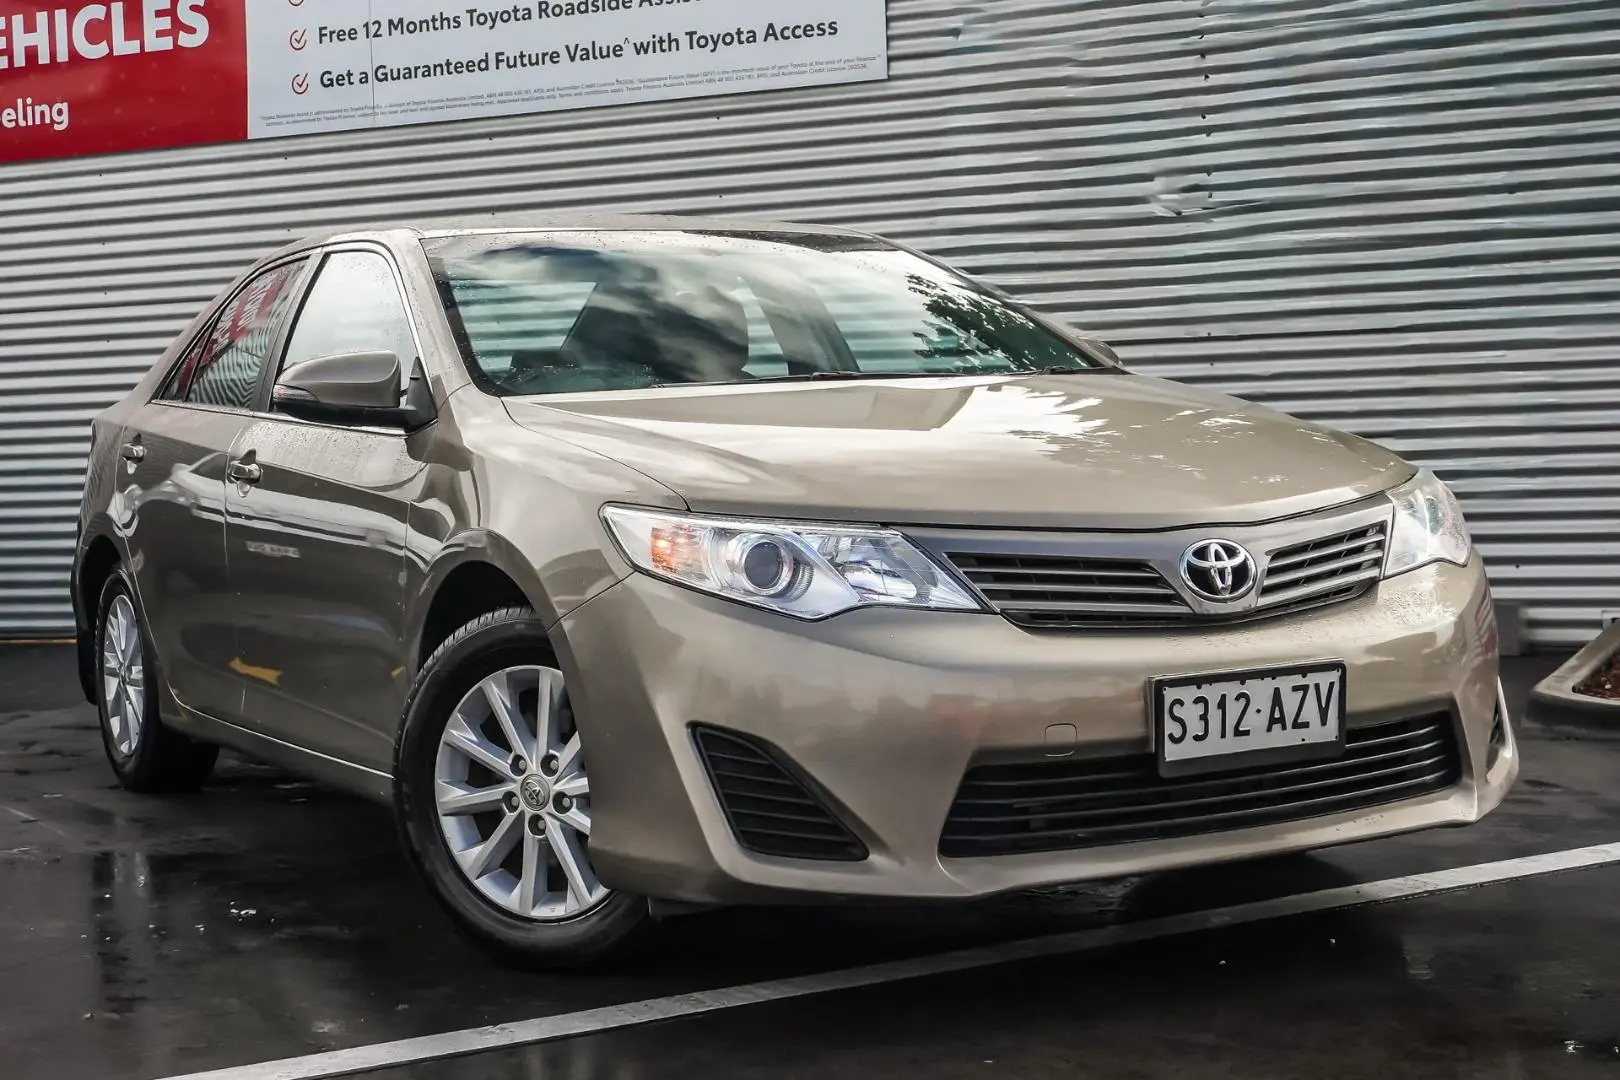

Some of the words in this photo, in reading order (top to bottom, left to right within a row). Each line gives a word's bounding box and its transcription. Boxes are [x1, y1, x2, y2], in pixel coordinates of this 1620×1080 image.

[318, 26, 358, 44] Free
[362, 20, 383, 39] 12
[387, 12, 461, 36] Months
[466, 5, 532, 30] Toyota
[538, 0, 633, 19] Roadside
[320, 69, 355, 88] Get
[358, 71, 369, 84] a
[374, 52, 489, 83] Guaranteed
[495, 50, 561, 70] Future
[633, 32, 680, 56] with
[685, 27, 757, 52] Toyota
[763, 20, 838, 42] Access
[0, 96, 69, 131] eling
